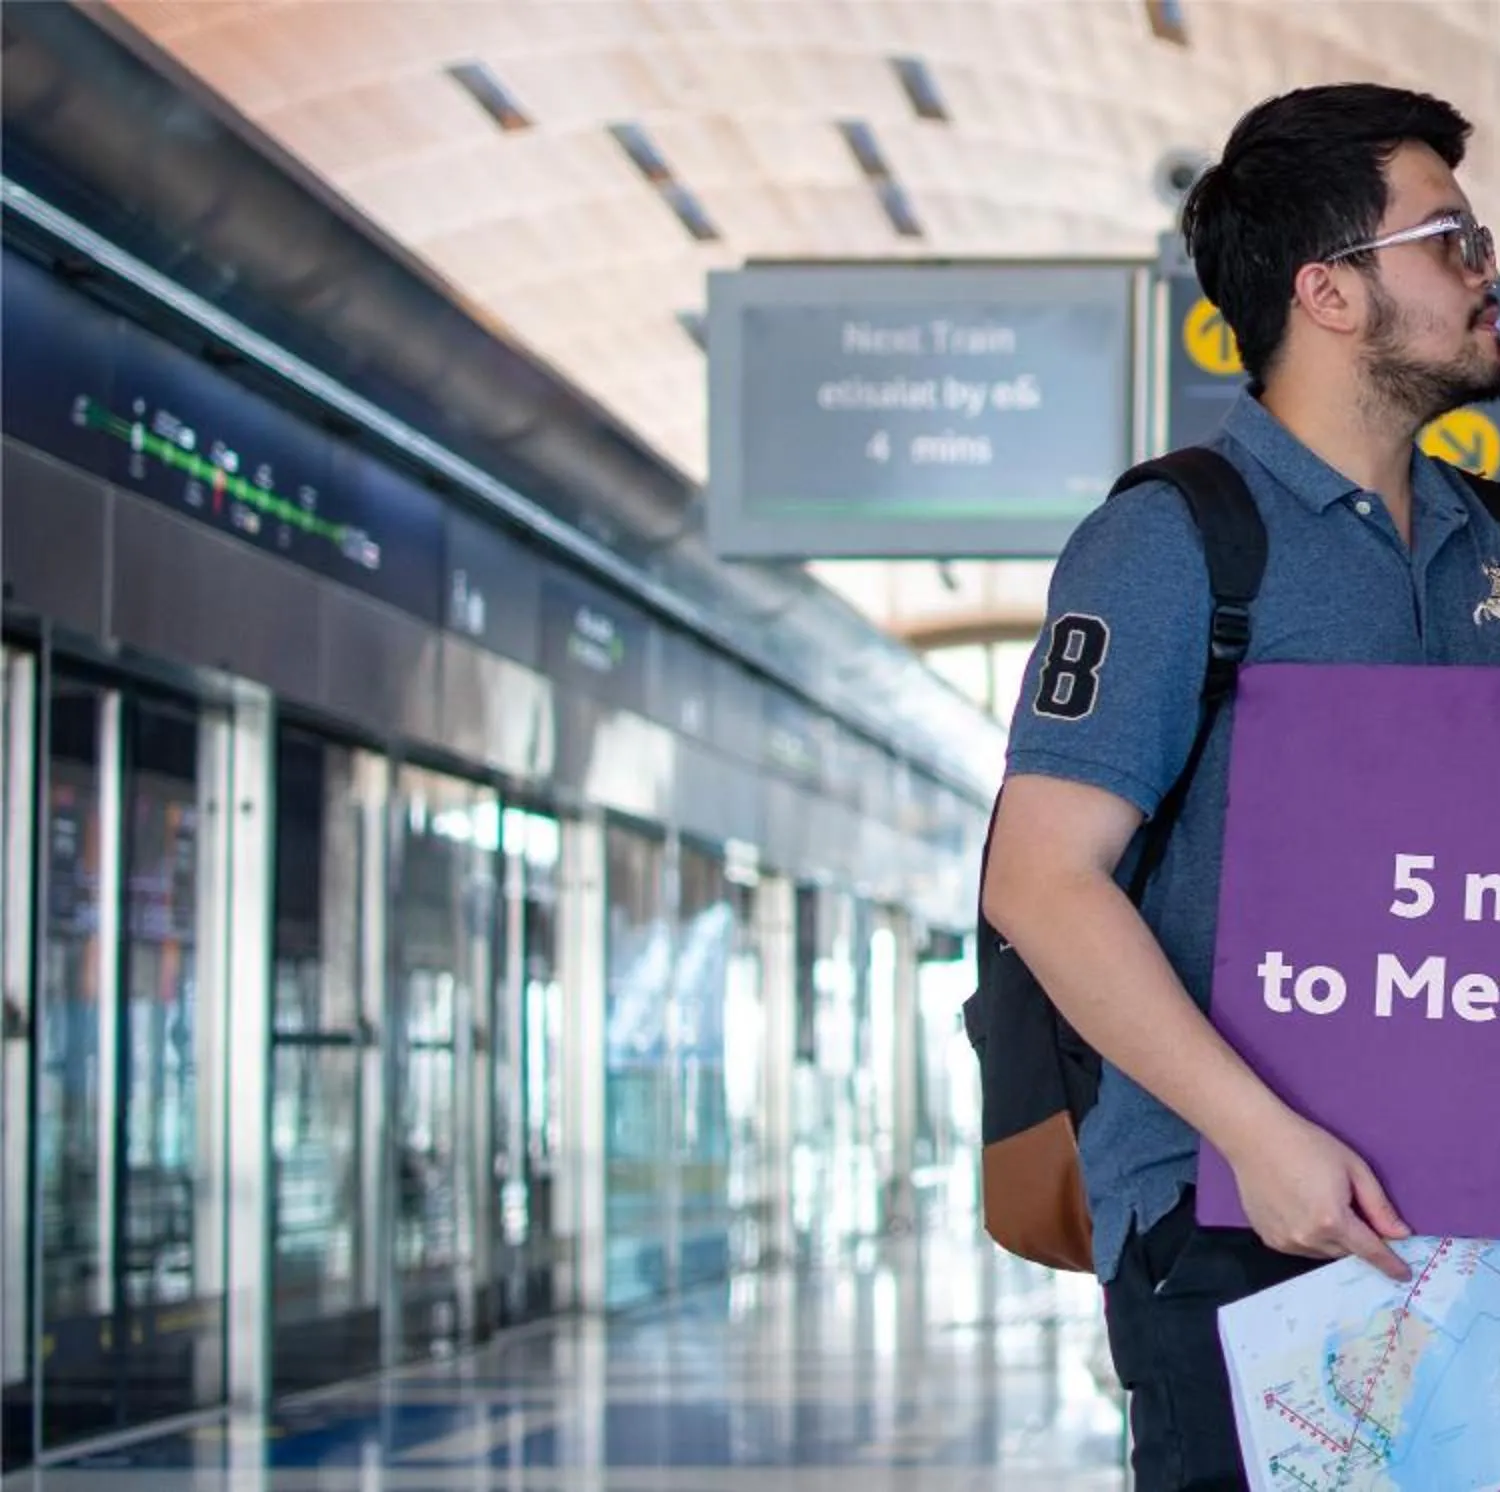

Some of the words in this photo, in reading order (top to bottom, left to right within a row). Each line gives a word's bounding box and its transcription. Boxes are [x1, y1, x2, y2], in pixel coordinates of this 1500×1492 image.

[841, 320, 920, 354] Next
[929, 319, 1016, 354] Train
[942, 375, 986, 418] by
[865, 429, 891, 464] 4
[909, 428, 994, 465] mins
[1032, 612, 1110, 721] 8
[1389, 853, 1436, 919] 5
[1257, 951, 1347, 1015] to
